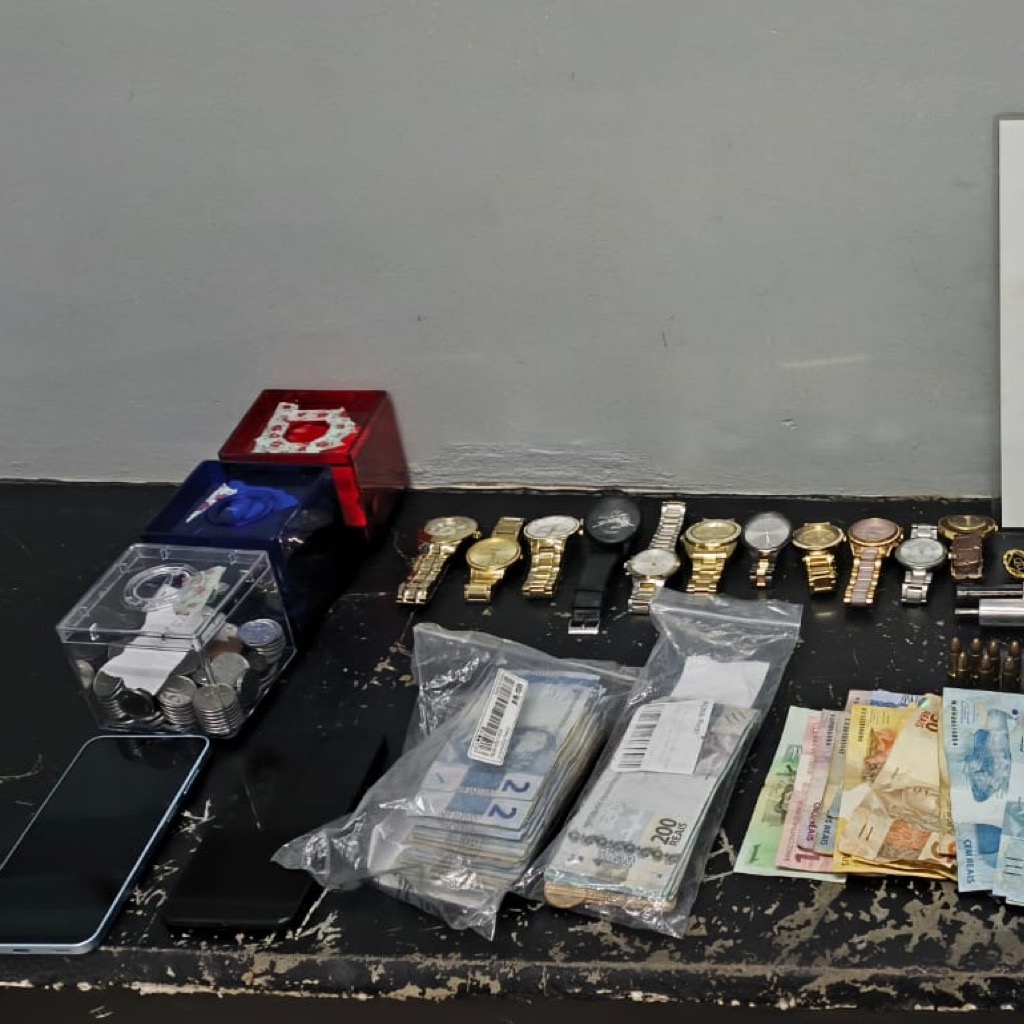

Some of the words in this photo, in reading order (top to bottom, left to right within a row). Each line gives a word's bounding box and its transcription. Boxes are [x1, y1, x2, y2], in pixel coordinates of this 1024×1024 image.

[502, 778, 530, 793] 2
[488, 804, 517, 819] 2
[652, 817, 678, 845] 200
[669, 822, 688, 847] REAIS
